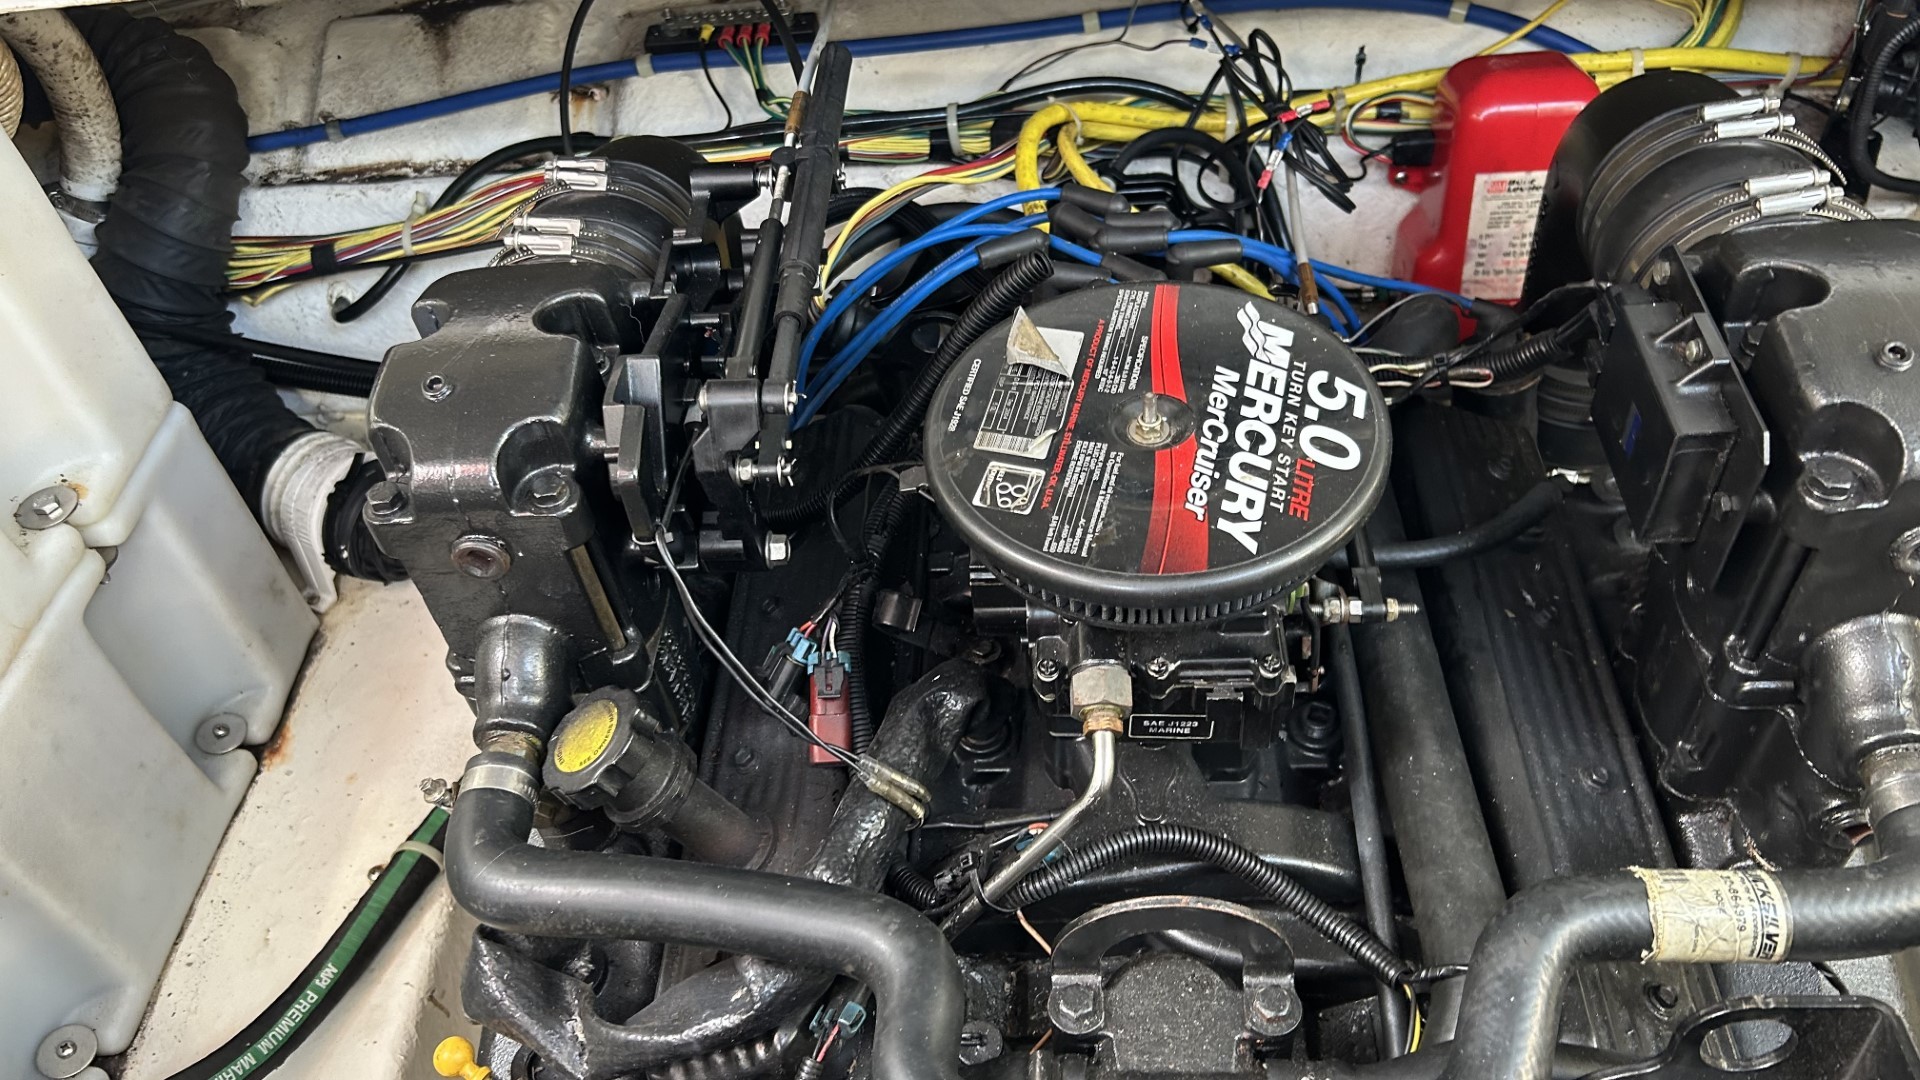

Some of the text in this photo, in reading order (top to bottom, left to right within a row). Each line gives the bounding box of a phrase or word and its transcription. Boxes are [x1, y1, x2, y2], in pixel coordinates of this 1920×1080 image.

[1120, 289, 1130, 311] IGNITION
[1124, 301, 1133, 318] FIRING
[1127, 290, 1143, 329] DISPLACEMENT
[1088, 324, 1103, 357] PRODUCT
[1094, 288, 1124, 379] SPECIAL IGNITION TIMING REQUIRED
[1085, 357, 1094, 368] OF
[1128, 334, 1149, 390] SPECIFICATIONS
[947, 357, 981, 433] CERTIFIED SAE J1928
[1074, 368, 1089, 403] MERCURY
[1065, 402, 1079, 431] MARINE,
[1080, 440, 1088, 453] IDLE
[1184, 365, 1241, 522] MerCruiser
[1217, 319, 1295, 555] MERCURY
[1269, 361, 1307, 513] TURN KEY START
[1289, 370, 1368, 521] 5.0 LITRE
[1071, 439, 1082, 460] ENGINE
[1076, 453, 1084, 466] RPM
[1092, 441, 1101, 458] PLUG
[1097, 442, 1108, 462] SPARK
[1109, 450, 1116, 458] to
[1115, 451, 1124, 463] For
[1063, 460, 1075, 487] ROTATION
[1088, 457, 1096, 470] GAP
[1099, 457, 1115, 490] Operations
[1112, 462, 1120, 475] fuel
[1066, 472, 1078, 497] NEUTRAL
[1108, 474, 1117, 486] and
[1040, 488, 1053, 510] U.S.A.
[1087, 495, 1104, 533] Maintenance
[1046, 526, 1054, 537] left
[1042, 536, 1051, 552] hand
[1080, 533, 1093, 557] Manual
[579, 756, 591, 767] SEE
[257, 990, 319, 1055] PREMIUM
